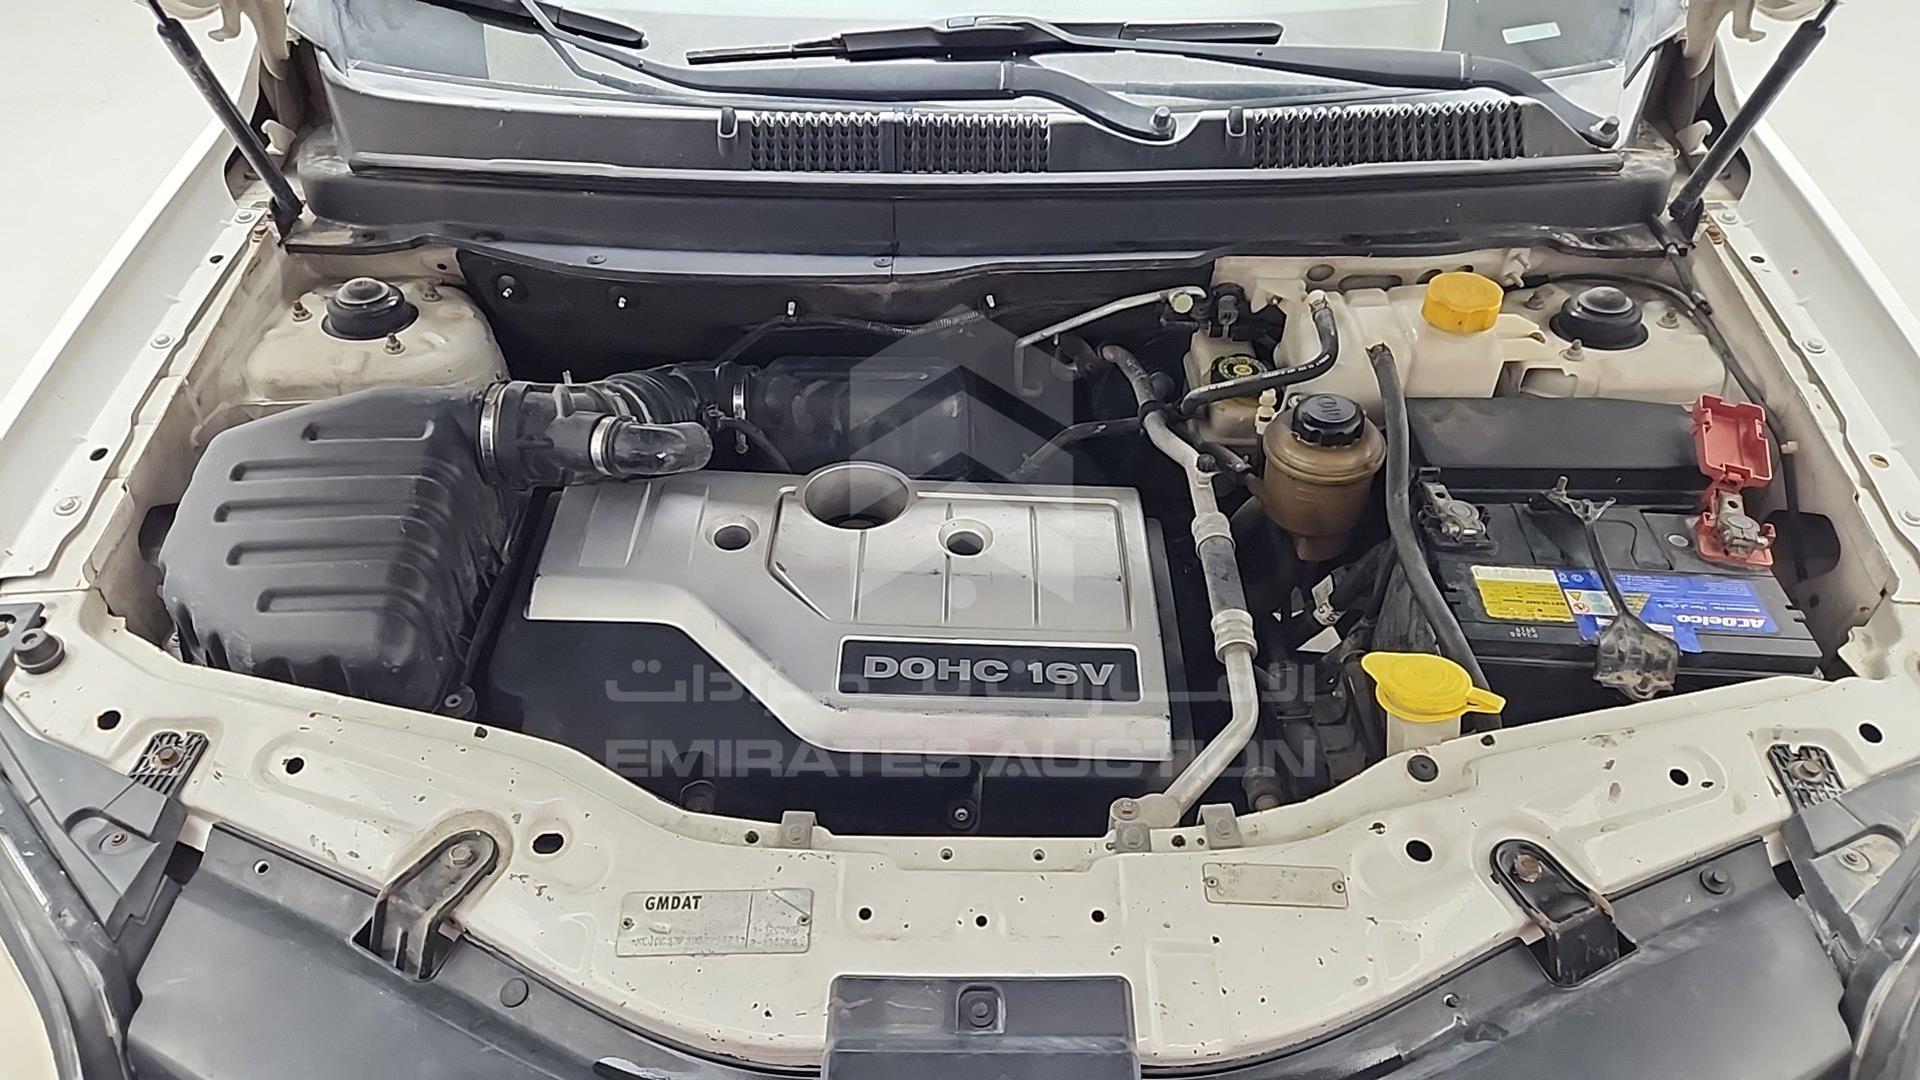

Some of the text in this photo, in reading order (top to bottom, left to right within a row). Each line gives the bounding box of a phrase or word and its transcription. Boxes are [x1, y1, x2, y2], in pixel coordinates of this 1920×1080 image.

[1676, 614, 1766, 629] ACDelco
[863, 656, 1115, 686] DOHC 16V
[645, 895, 702, 910] GMDAT
